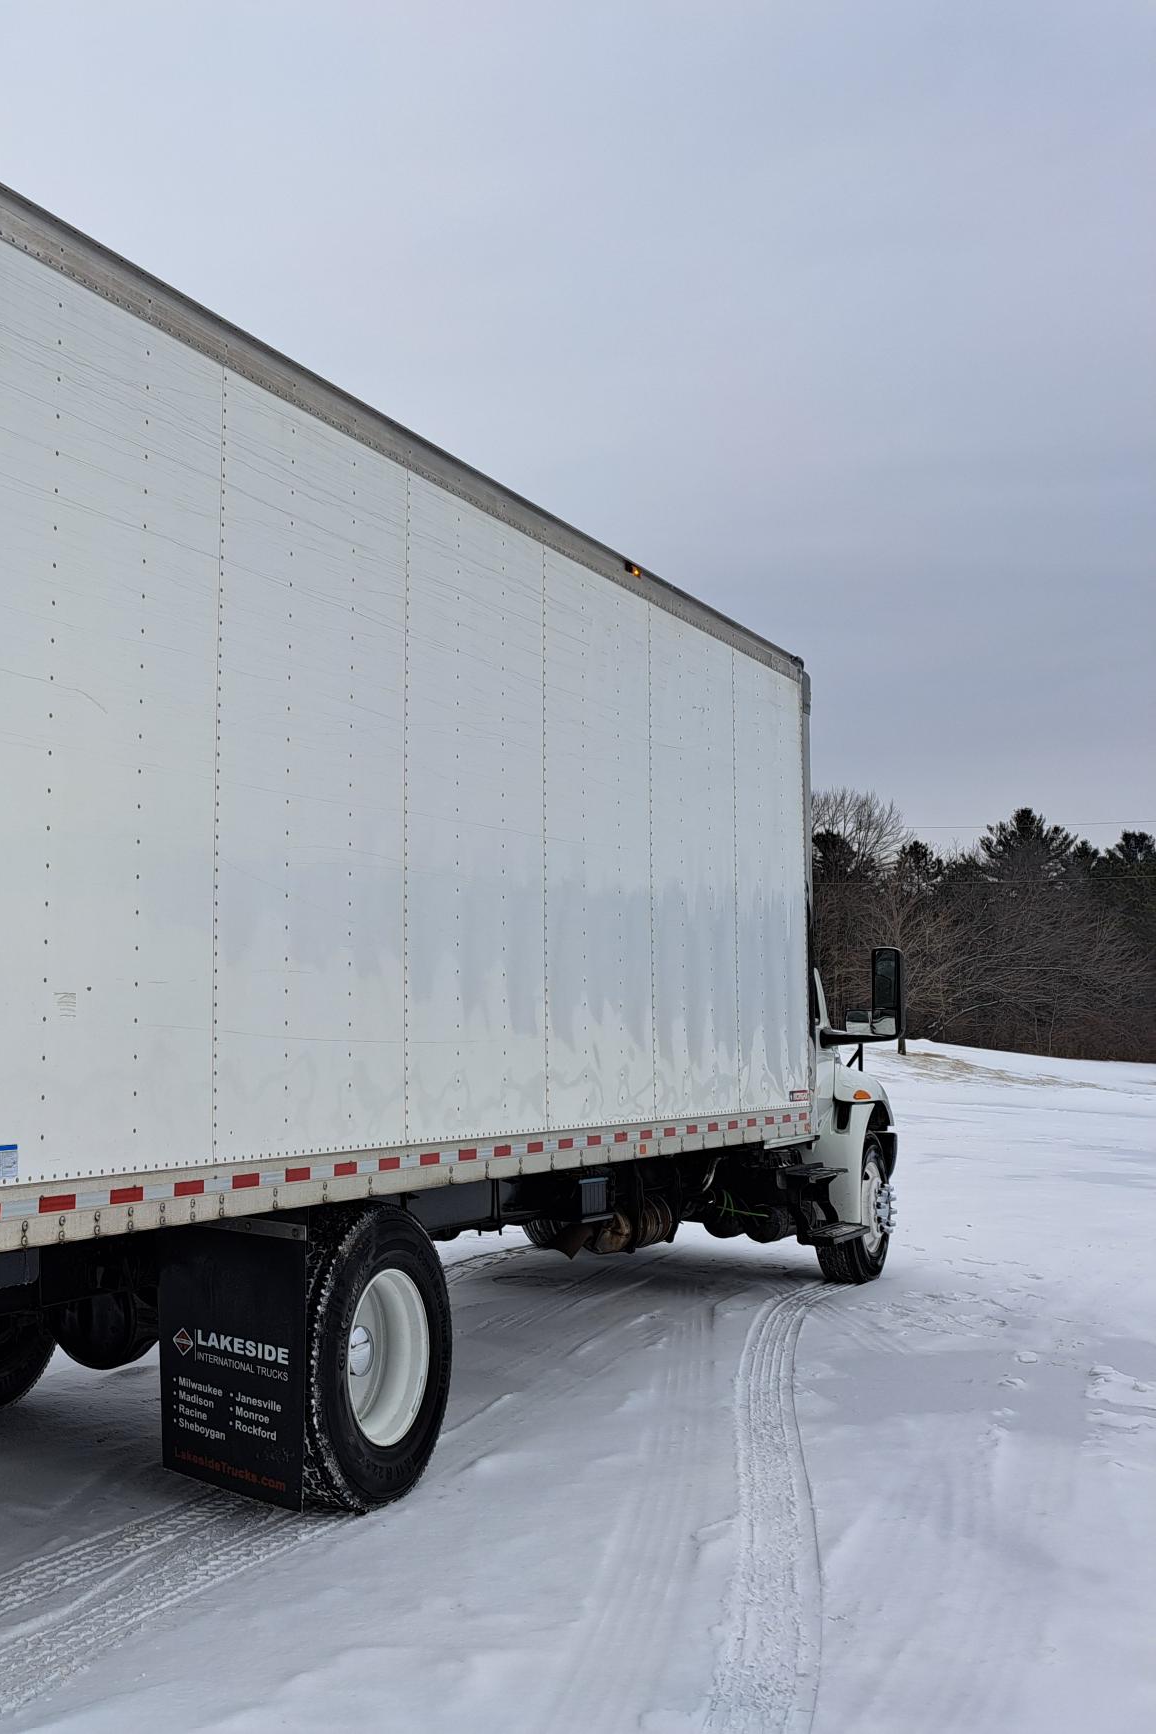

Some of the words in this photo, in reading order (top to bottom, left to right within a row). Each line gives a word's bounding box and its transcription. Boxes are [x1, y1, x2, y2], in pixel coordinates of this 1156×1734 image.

[197, 1329, 289, 1365] LAKESIDE
[197, 1351, 255, 1374] INTERNATIONAL
[256, 1365, 289, 1382] TRUCKS
[178, 1376, 223, 1397] Milwaukee
[178, 1390, 215, 1409] Madison
[235, 1392, 282, 1413] Janesville
[178, 1403, 208, 1421] Racine
[235, 1405, 270, 1424] Monroe
[178, 1417, 226, 1441] Sheboygan
[235, 1420, 277, 1441] Rockford
[174, 1446, 286, 1492] LakesideTrucks.com
